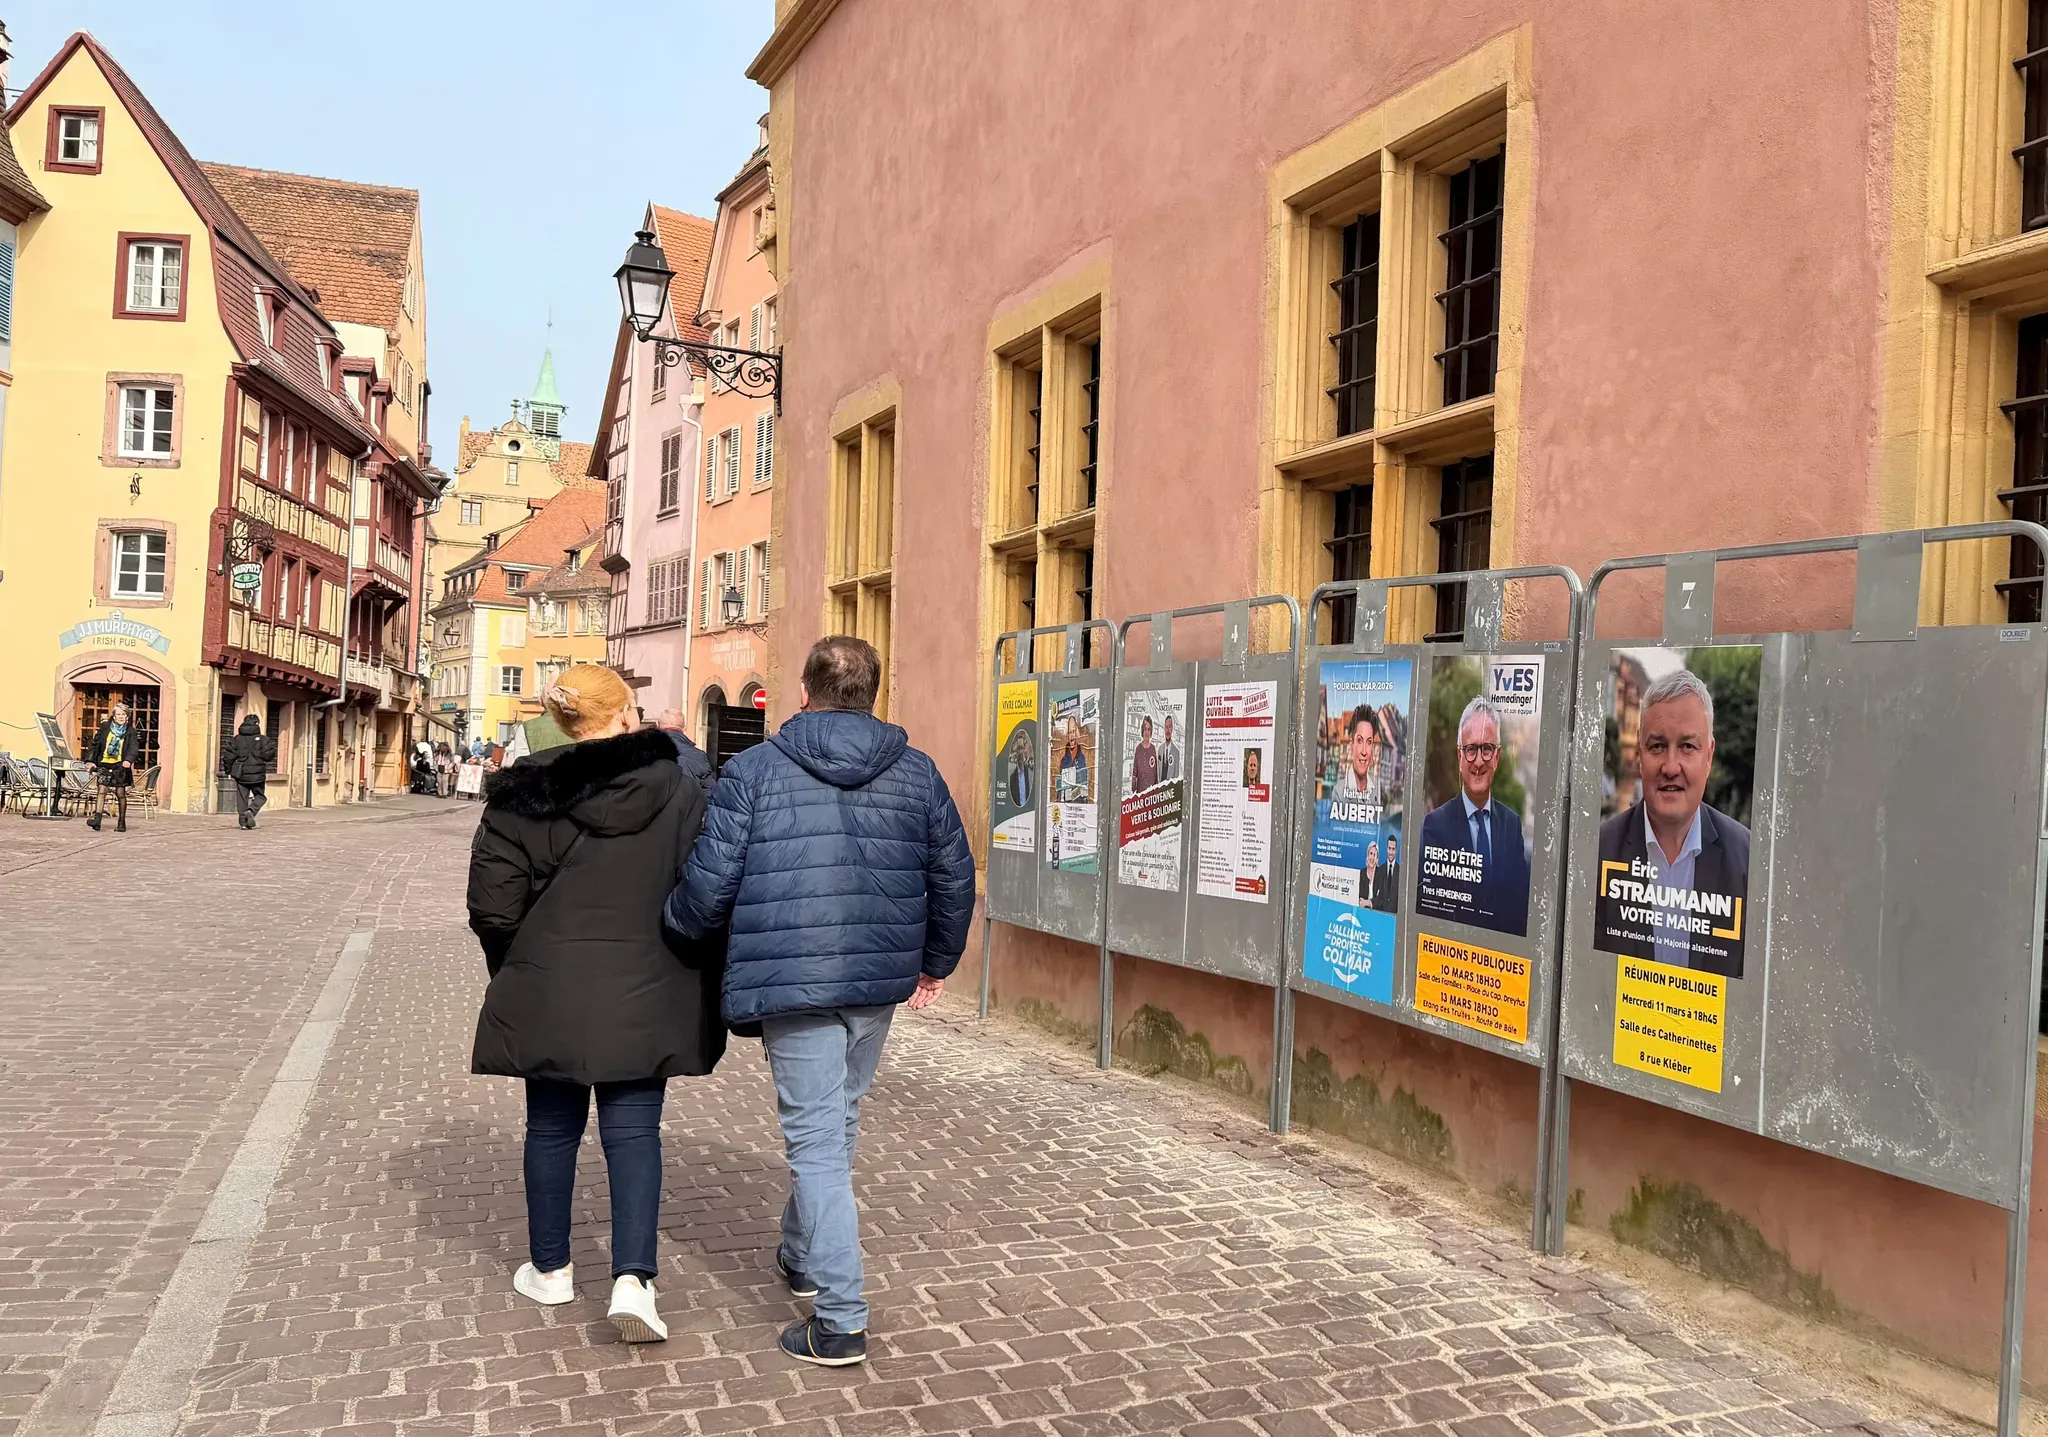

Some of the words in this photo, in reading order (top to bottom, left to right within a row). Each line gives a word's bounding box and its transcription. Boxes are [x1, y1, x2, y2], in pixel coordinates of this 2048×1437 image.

[1682, 582, 1696, 610] 7
[1474, 606, 1485, 629] 6
[92, 637, 116, 646] IRISH
[119, 637, 137, 647] PUB
[1231, 624, 1239, 643] 4
[724, 649, 756, 671] COLMAR
[1333, 681, 1350, 690] POUR
[1350, 681, 1377, 691] COLMAR
[1377, 681, 1394, 690] 2026
[1494, 668, 1534, 692] YvES
[1002, 700, 1014, 709] VIVRE
[1015, 699, 1033, 709] COLMAR
[1206, 696, 1222, 706] LUTTE
[1206, 705, 1234, 717] OUVRIÈRE
[1491, 693, 1533, 707] Hemedinger
[1121, 798, 1144, 814] COLMAR
[1144, 788, 1175, 807] CITOYENNE
[1343, 788, 1371, 800] Nathalie
[1131, 811, 1148, 825] VERTE
[1152, 800, 1181, 819] SOLIDAIRE
[1329, 802, 1384, 825] AUBERT
[1424, 845, 1449, 861] FIERS
[1450, 847, 1483, 867] D'ÊTRE
[1631, 856, 1659, 879] Éric
[1423, 860, 1482, 884] COLMARIENS
[1422, 884, 1435, 895] Yves
[1435, 887, 1472, 903] HEMEDINGER
[1608, 878, 1732, 918] STRAUMANN
[1619, 905, 1663, 927] VOTRE
[1666, 913, 1711, 935] MAIRE
[1328, 922, 1371, 944] L'ALLIANCE
[1606, 926, 1621, 937] Liste
[1622, 930, 1645, 941] d'union
[1646, 932, 1656, 943] de
[1656, 935, 1663, 944] la
[1664, 936, 1691, 950] Majorité
[1692, 942, 1728, 957] alsacienne
[1331, 936, 1363, 954] DROITES
[1422, 938, 1468, 961] RÉUNIONS
[1471, 952, 1525, 975] PUBLIQUES
[1323, 945, 1372, 975] COLMAR
[1441, 964, 1450, 975] 10
[1452, 967, 1474, 982] MARS
[1476, 973, 1501, 989] 18H30
[1624, 964, 1666, 986] RÉUNION
[1668, 976, 1718, 997] PUBLIQUE
[1431, 975, 1441, 983] des
[1441, 977, 1462, 989] Familles
[1466, 984, 1480, 995] Place
[1481, 989, 1489, 997] du
[1503, 995, 1526, 1007] Dreyfus
[1440, 992, 1448, 1003] 13
[1450, 995, 1472, 1010] MARS
[1474, 1002, 1499, 1017] 18H30
[1622, 993, 1654, 1010] Mercredi
[1656, 1001, 1665, 1012] 11
[1666, 1006, 1686, 1017] mars
[1687, 1007, 1692, 1018] à
[1694, 1010, 1718, 1025] 18h45
[1440, 1005, 1450, 1014] des
[1451, 1008, 1471, 1020] Truites
[1476, 1015, 1493, 1027] Route
[1494, 1021, 1503, 1030] de
[1619, 1019, 1640, 1033] Salle
[1641, 1025, 1656, 1037] des
[1658, 1028, 1717, 1053] Catherinettes
[1639, 1051, 1645, 1061] 8
[1646, 1054, 1661, 1066] rue
[1663, 1057, 1692, 1074] Kléber
